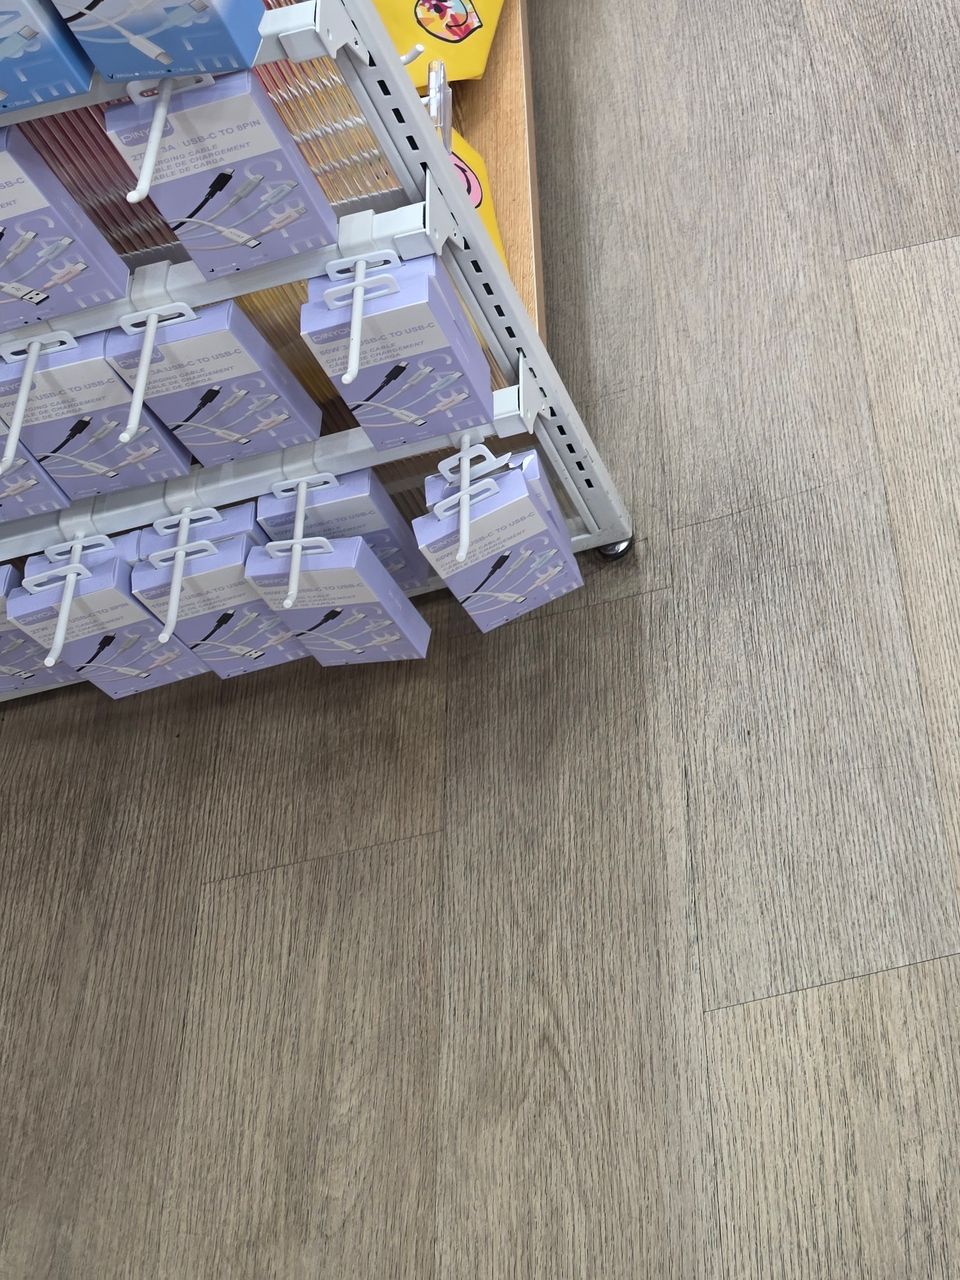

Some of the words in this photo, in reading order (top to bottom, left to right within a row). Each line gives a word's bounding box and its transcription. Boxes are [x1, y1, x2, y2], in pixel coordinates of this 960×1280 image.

[182, 132, 218, 148] USB-C
[219, 126, 234, 137] TO
[188, 144, 218, 156] CABLE
[189, 142, 252, 164] CHARGEMENT
[390, 330, 404, 339] TO
[405, 321, 435, 335] USB-C
